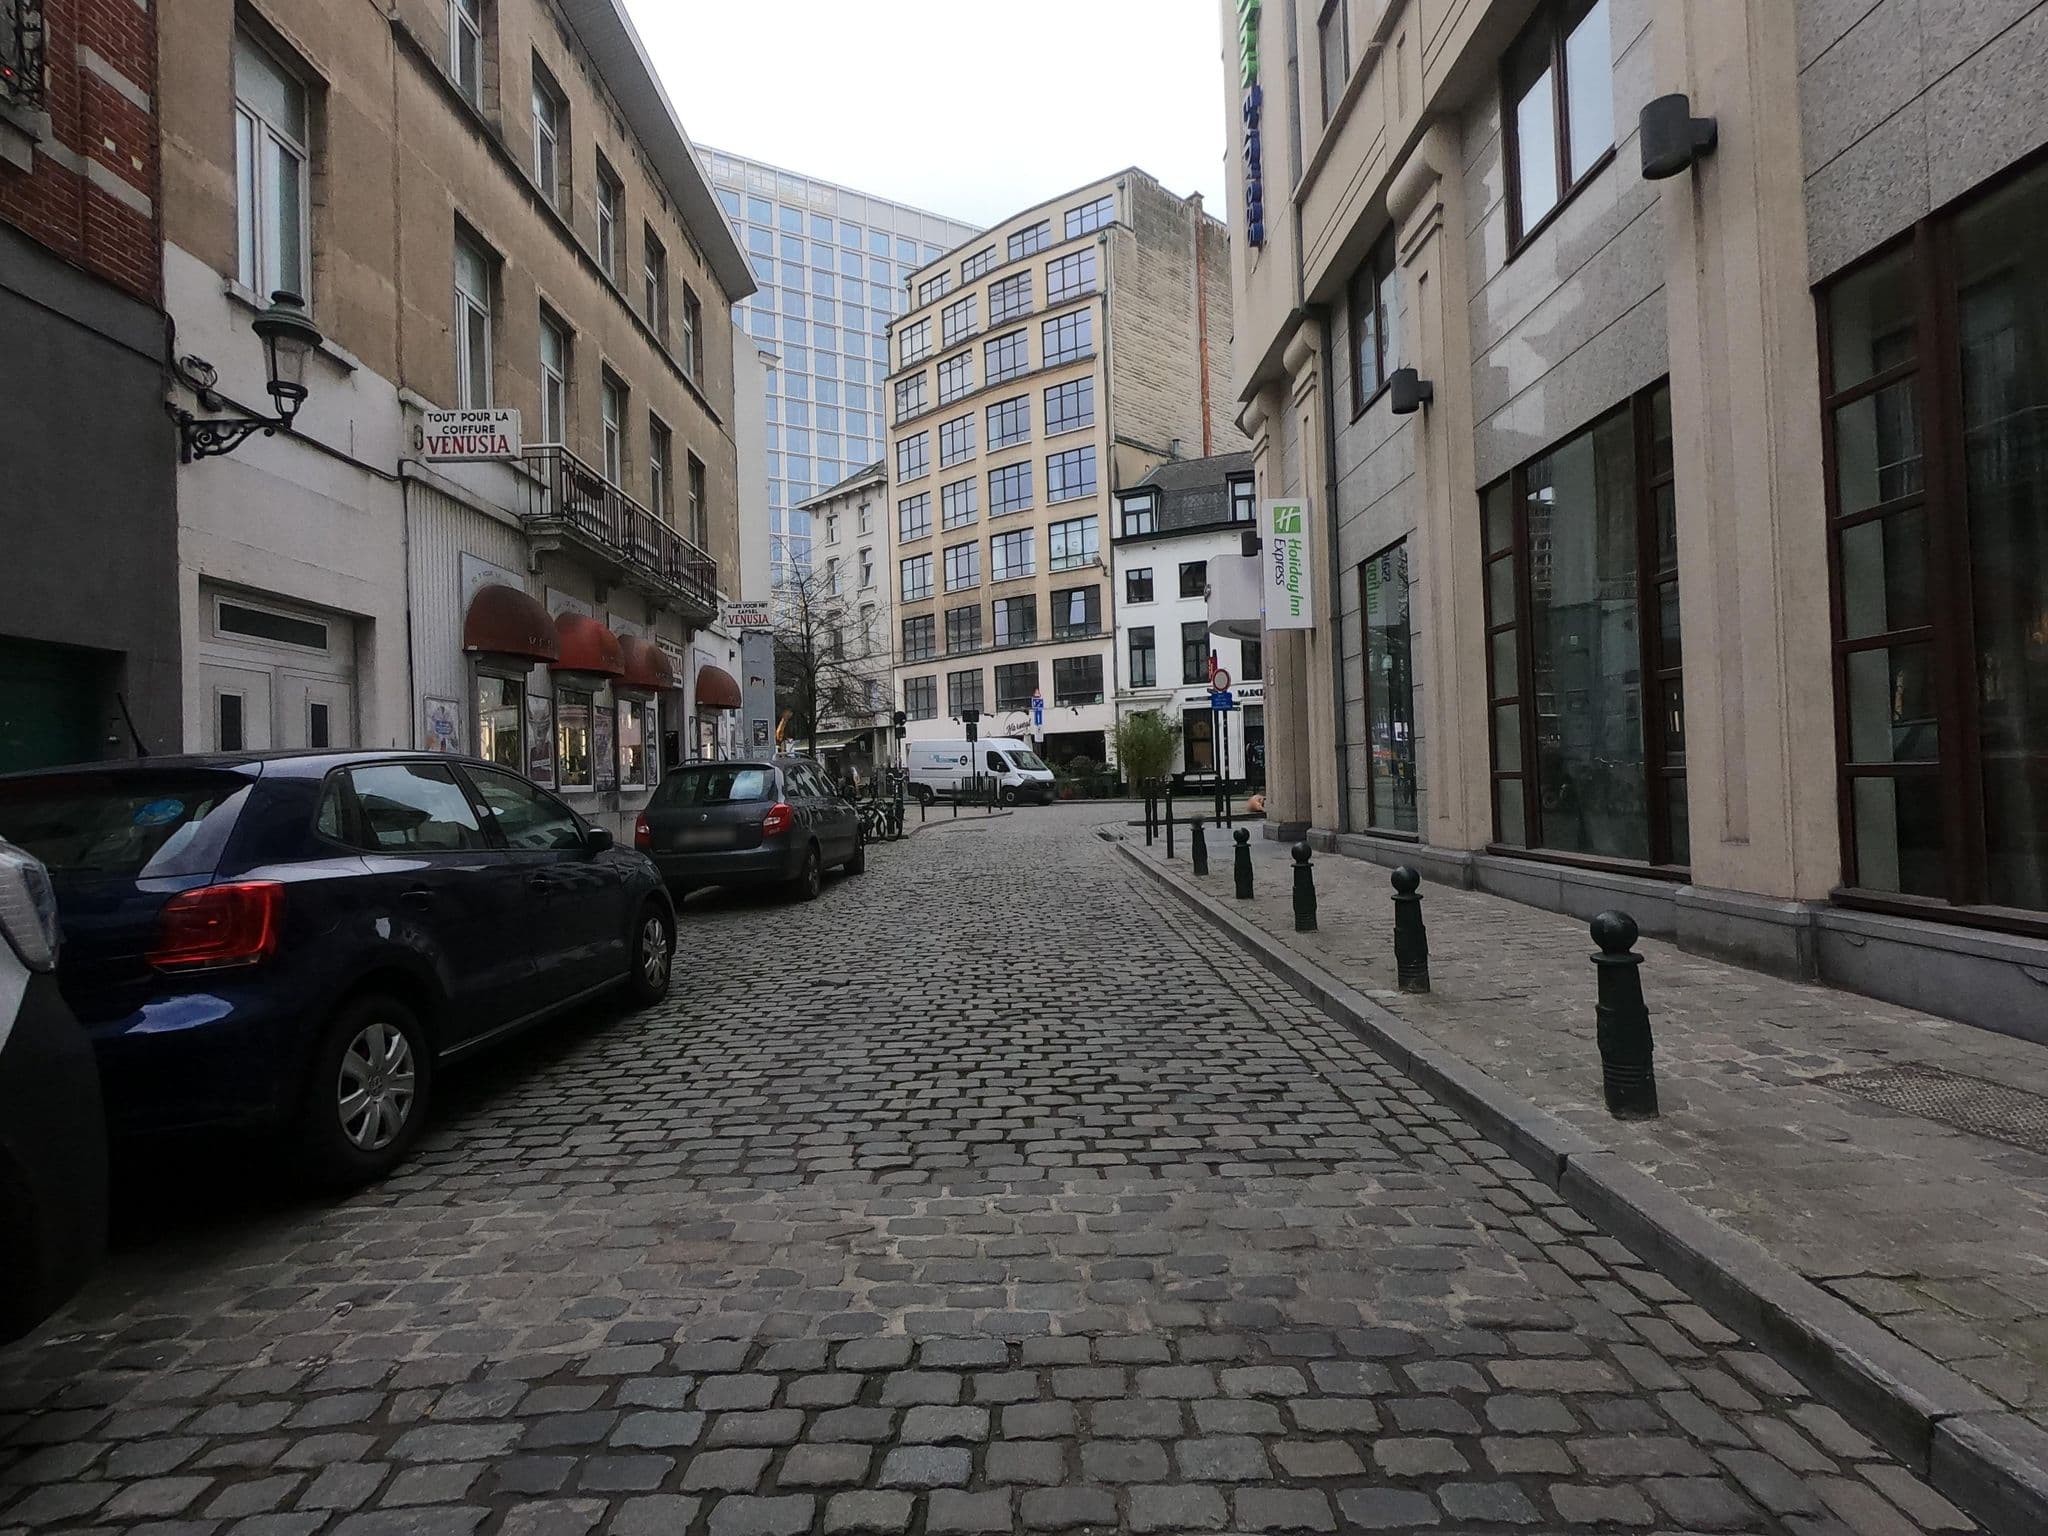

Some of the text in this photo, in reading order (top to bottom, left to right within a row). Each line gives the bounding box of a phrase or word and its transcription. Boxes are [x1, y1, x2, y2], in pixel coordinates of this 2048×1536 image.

[428, 412, 509, 423] TOUT POUR LA
[442, 425, 496, 434] COIFFURE
[427, 435, 510, 454] VENUSIA
[1272, 538, 1287, 586] Express
[1286, 538, 1304, 617] Holiday Inn
[728, 614, 769, 624] VENUSIA
